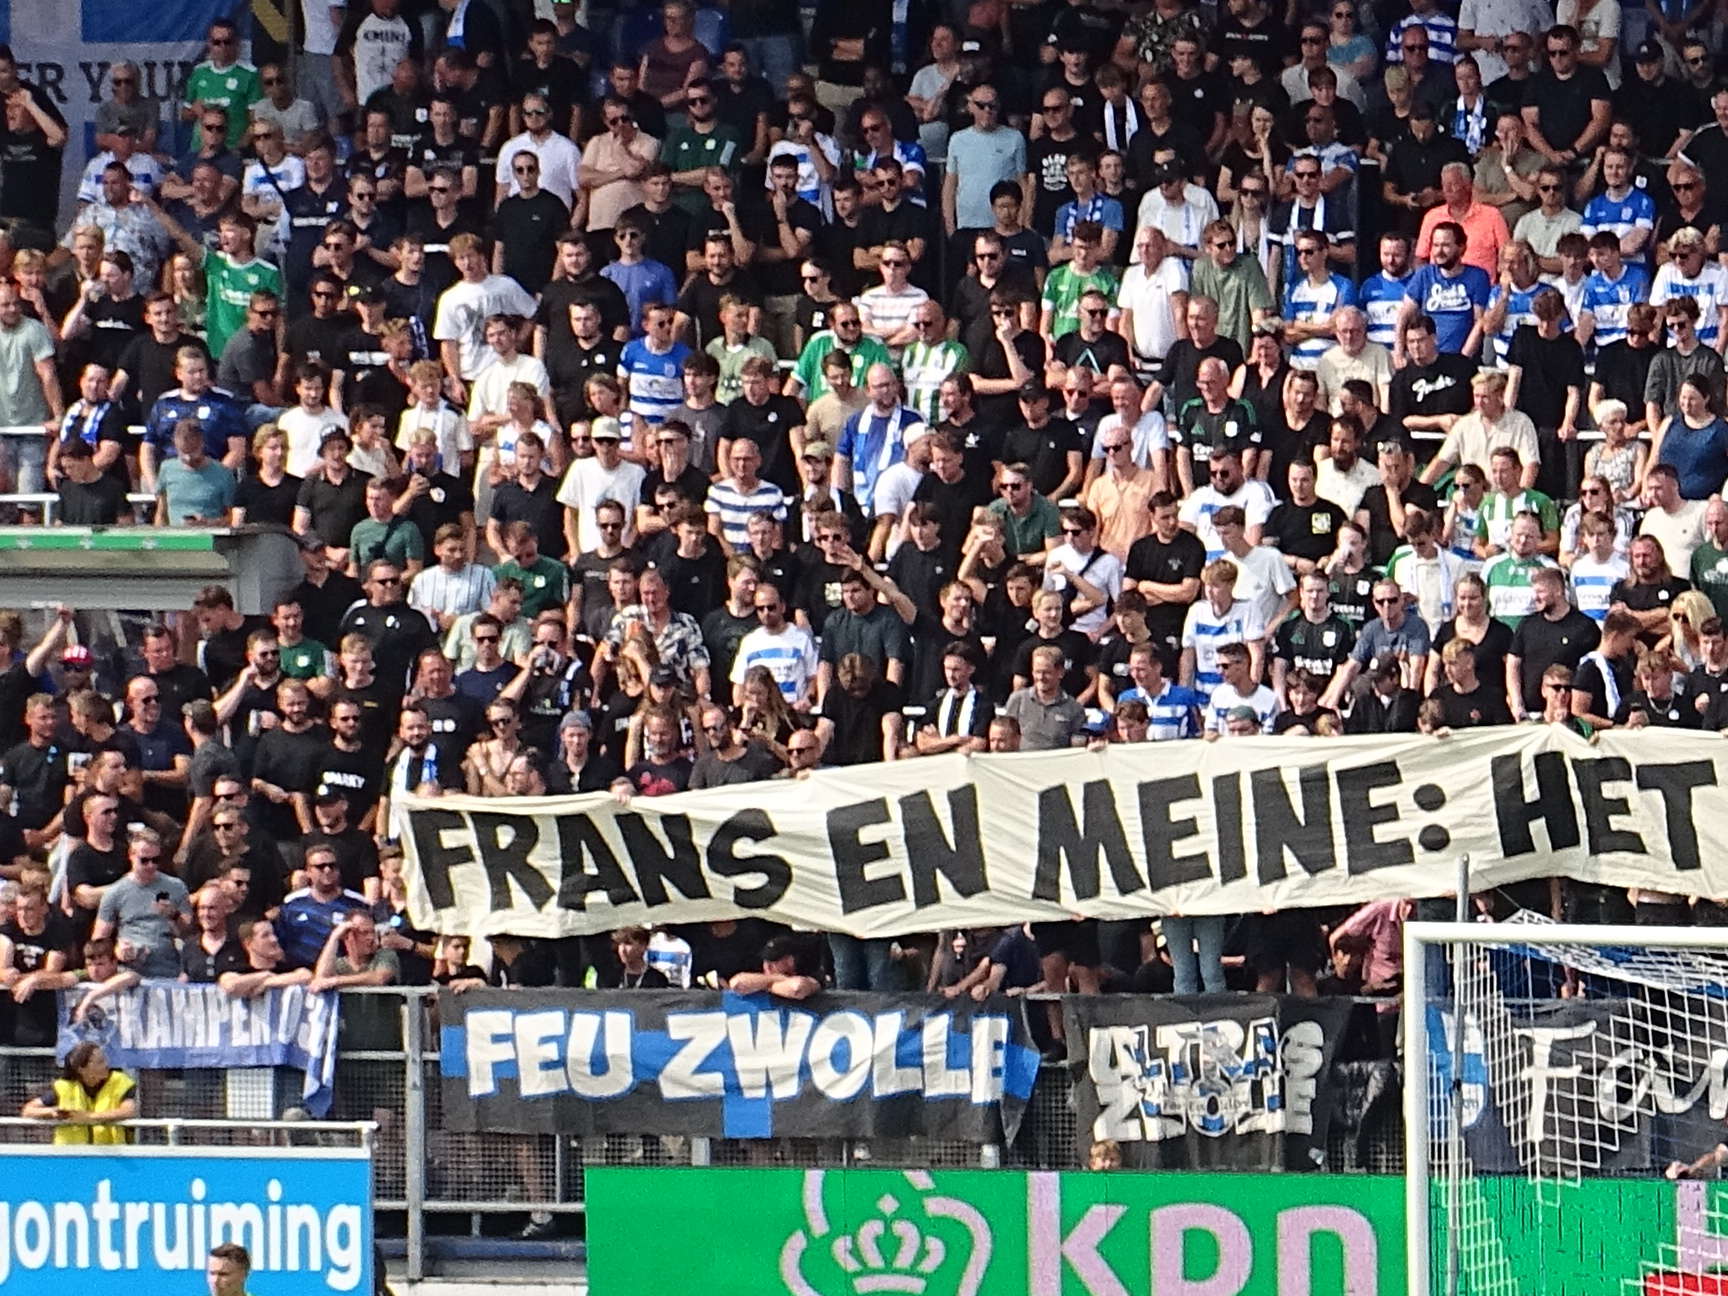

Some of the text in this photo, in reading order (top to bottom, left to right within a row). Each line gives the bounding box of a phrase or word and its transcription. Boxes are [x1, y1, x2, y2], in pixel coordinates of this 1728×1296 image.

[408, 807, 794, 912] FRANS
[826, 782, 989, 916] EN
[1032, 760, 1451, 902] MEINE:
[1491, 750, 1718, 870] HET
[465, 1008, 1011, 1104] FEU ZWOLLE
[0, 1177, 362, 1292] ontruiming
